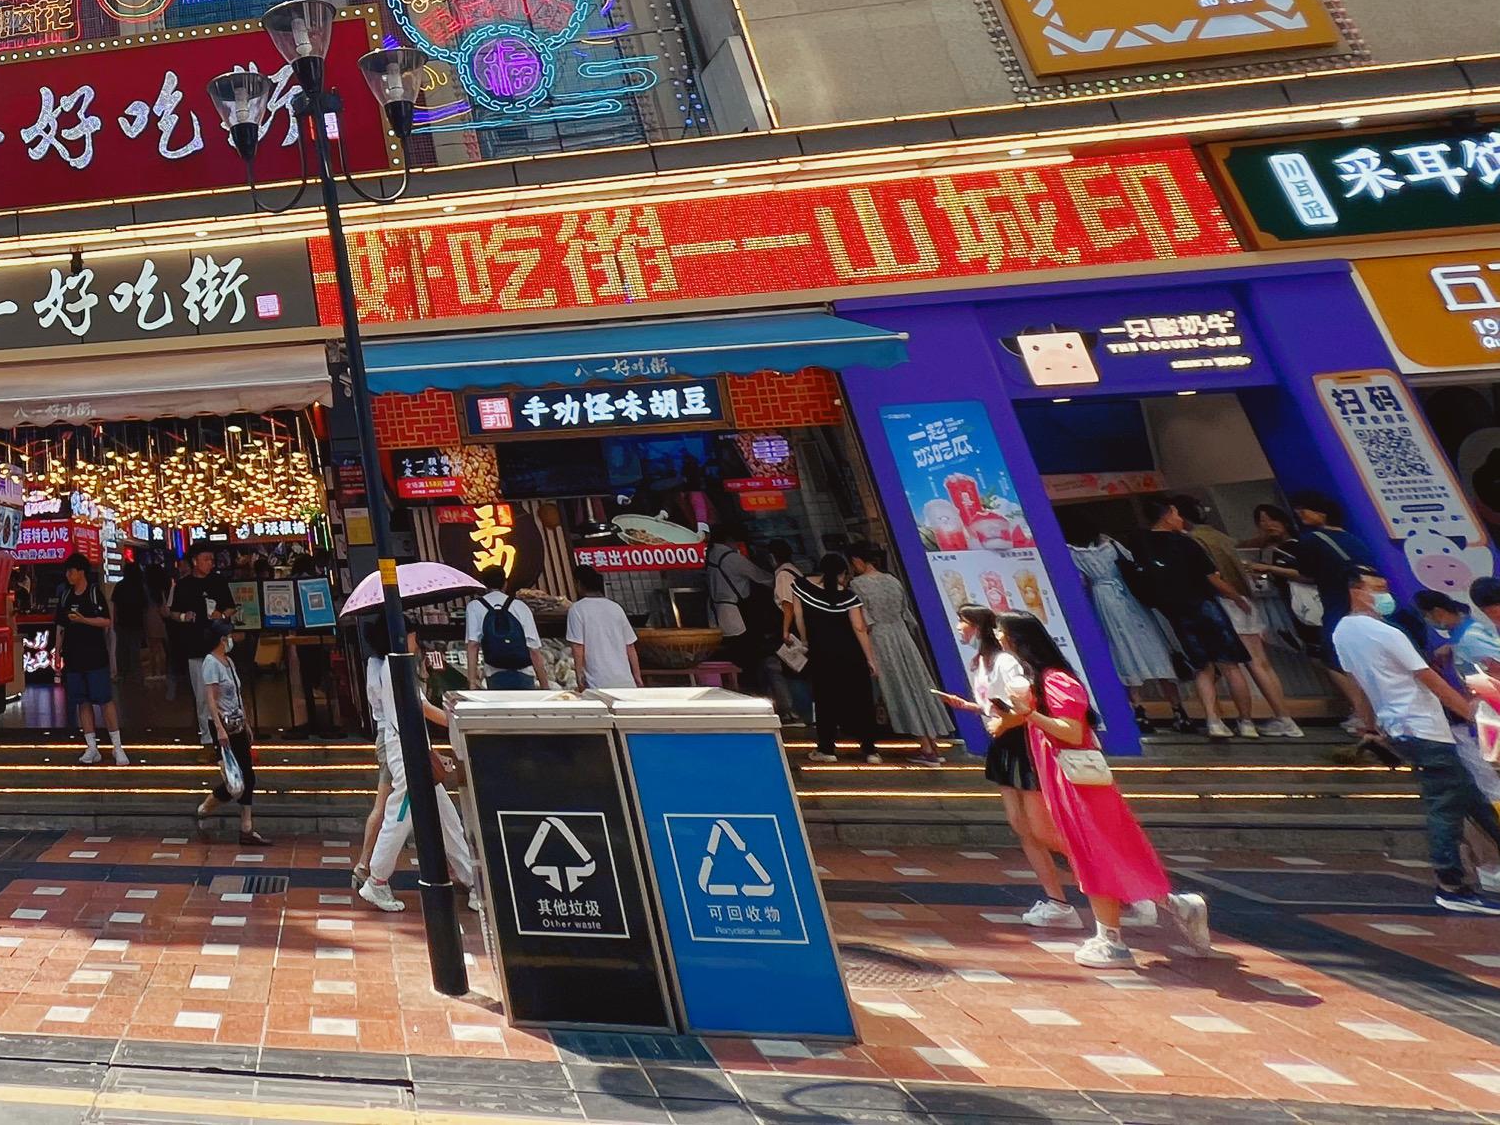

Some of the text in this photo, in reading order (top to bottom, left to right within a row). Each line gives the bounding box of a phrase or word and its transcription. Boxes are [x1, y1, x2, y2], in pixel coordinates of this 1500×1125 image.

[1100, 313, 1236, 339] 一只酸奶牛
[521, 386, 712, 426] 手功怪味胡豆
[1331, 385, 1404, 416] 扫码
[469, 504, 517, 580] 手功
[537, 897, 602, 918] 其他垃圾
[707, 904, 781, 924] 可回收物
[542, 918, 602, 931] Other waste
